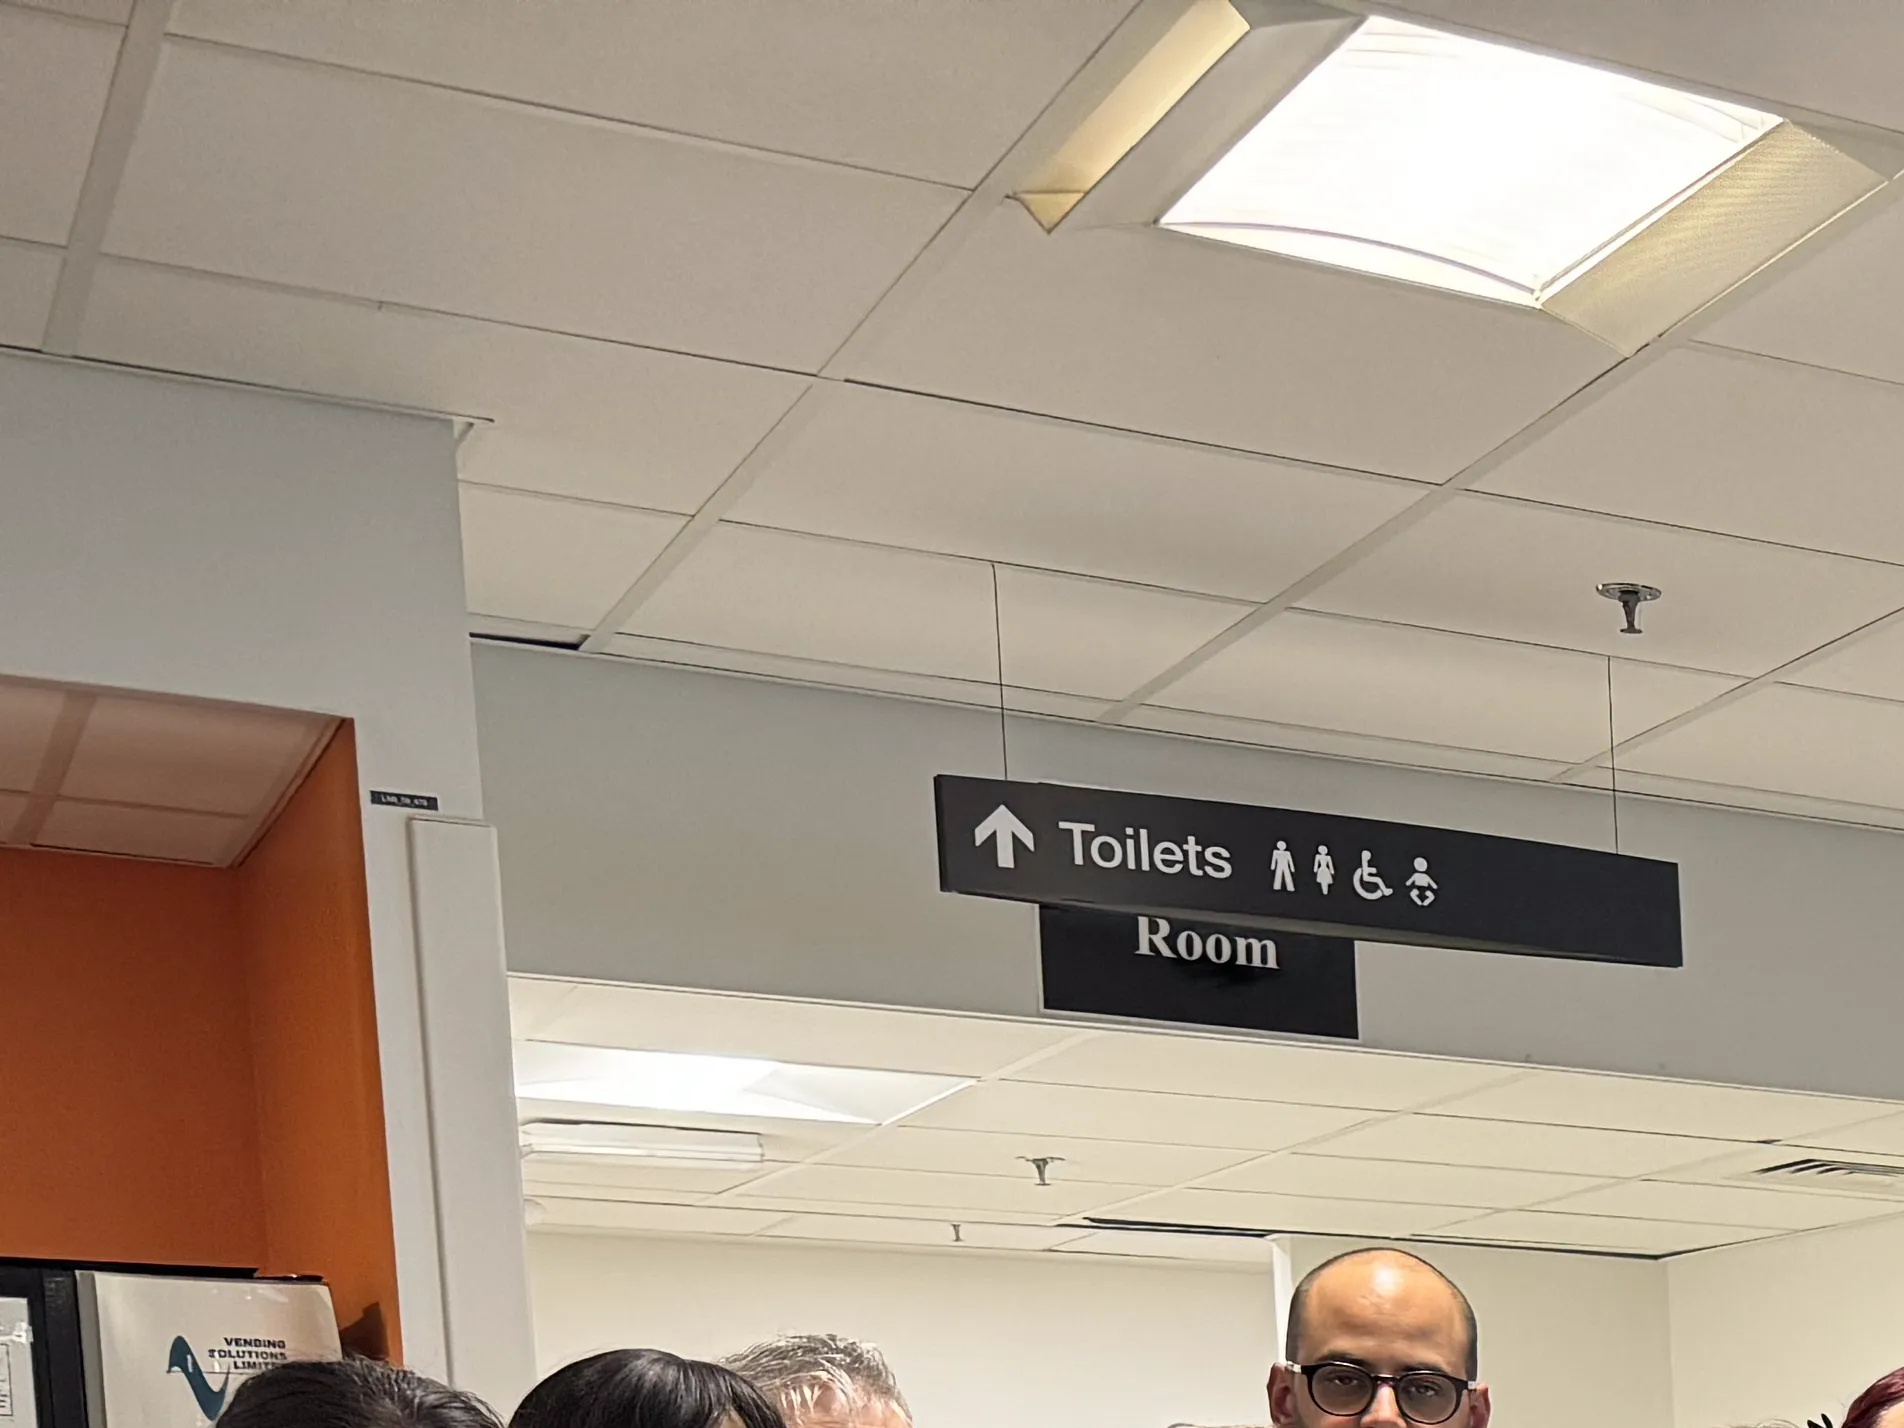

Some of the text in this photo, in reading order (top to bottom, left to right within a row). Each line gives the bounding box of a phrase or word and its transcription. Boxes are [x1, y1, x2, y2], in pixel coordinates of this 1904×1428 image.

[1058, 820, 1233, 880] Toilets
[1135, 915, 1281, 970] Room
[223, 1337, 286, 1349] VENDING
[208, 1349, 288, 1361] SOLUTIONS
[233, 1361, 277, 1371] LIMIT
